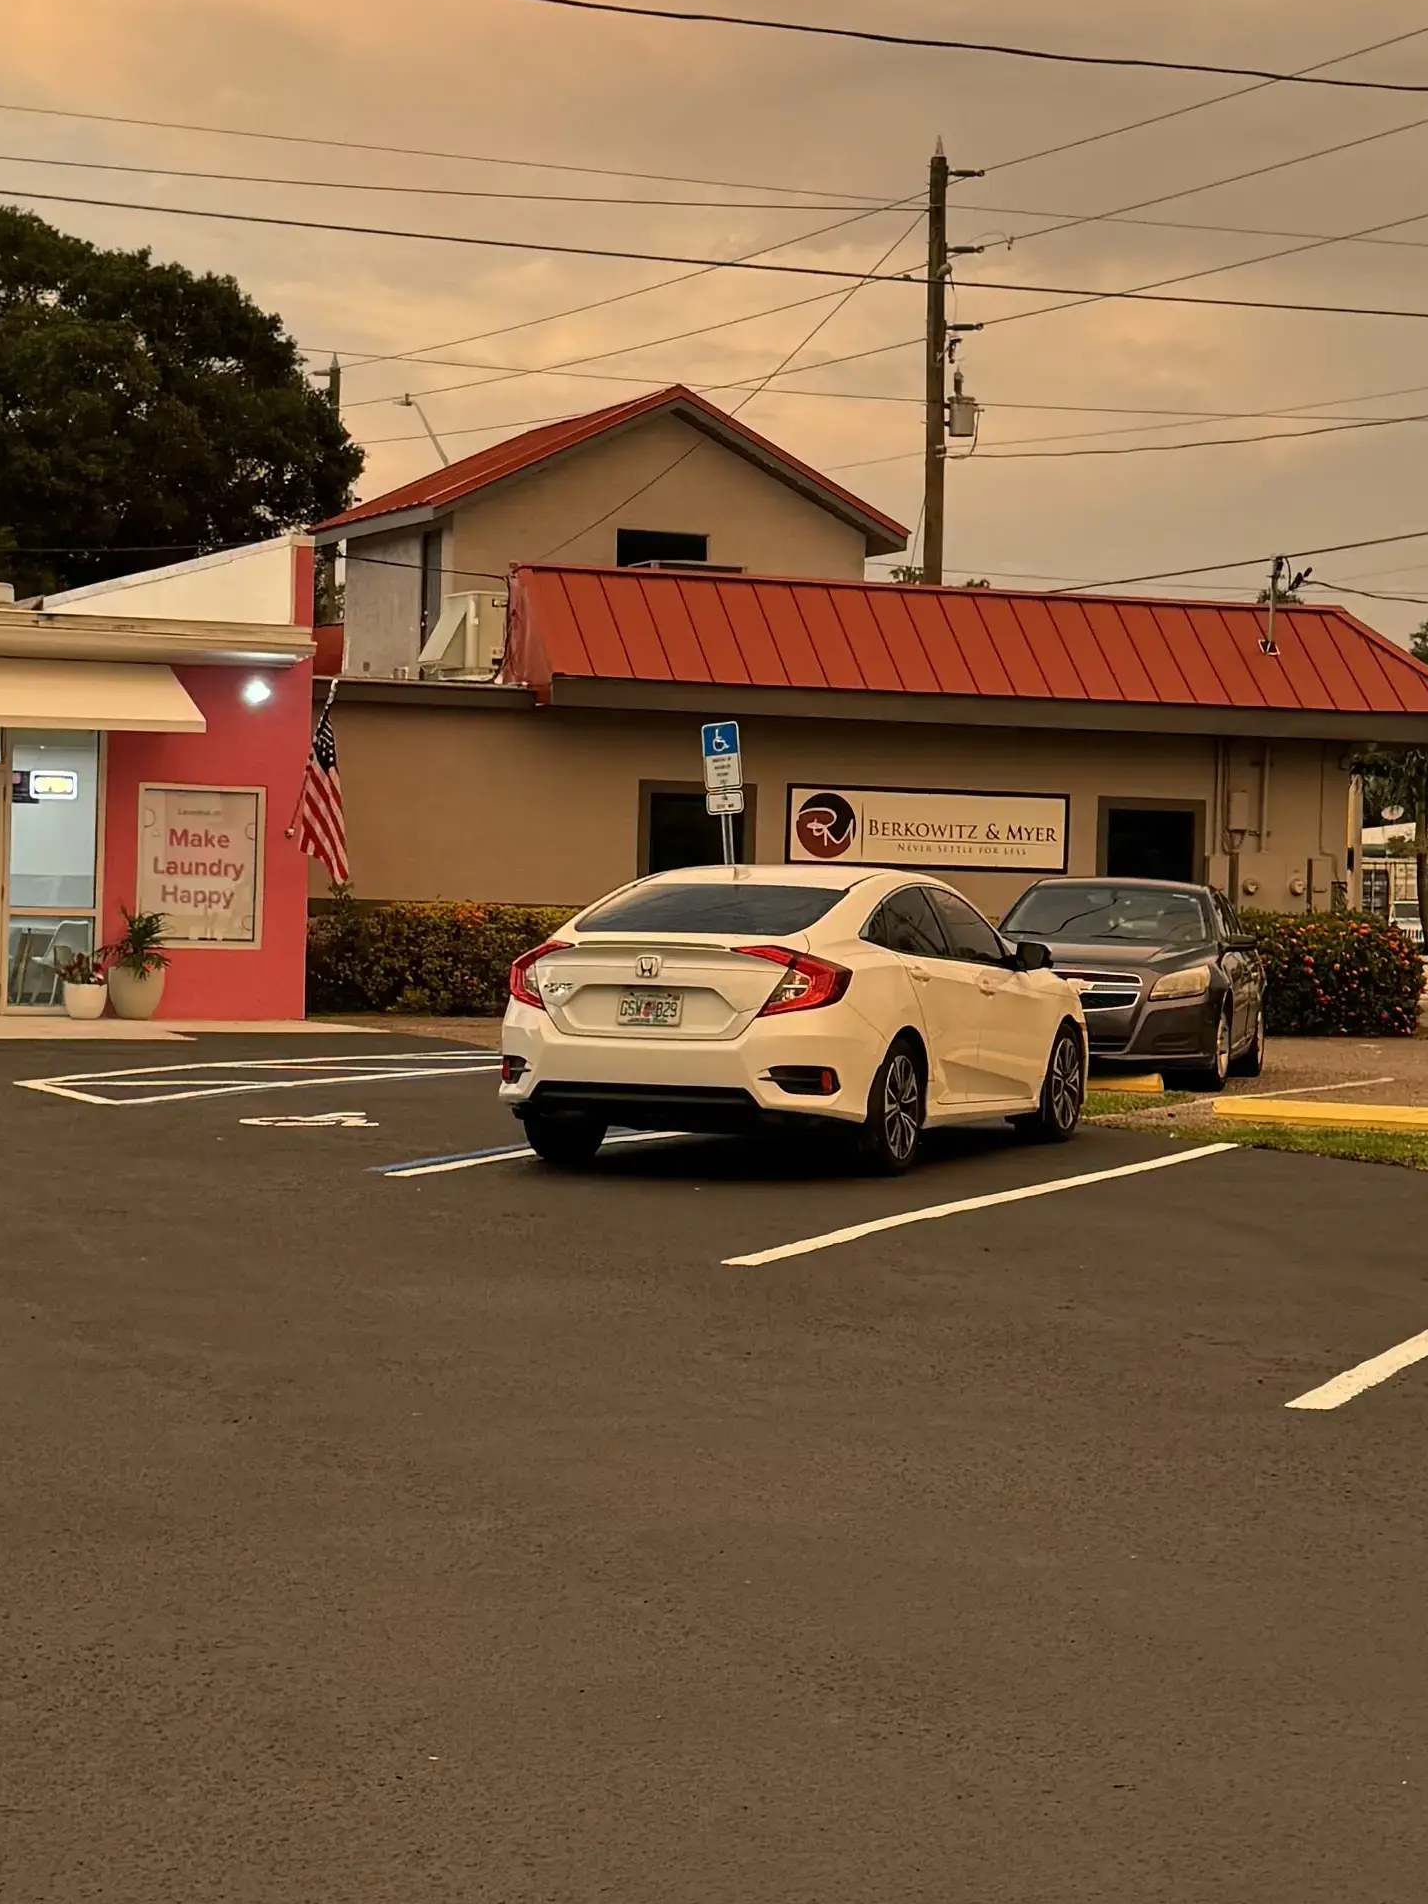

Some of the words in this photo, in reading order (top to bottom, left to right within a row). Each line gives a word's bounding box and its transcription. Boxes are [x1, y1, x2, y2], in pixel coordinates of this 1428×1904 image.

[169, 828, 230, 849] Make
[868, 818, 978, 840] BERKOWITZ
[985, 823, 1000, 840] &
[1006, 825, 1057, 842] MYER
[153, 856, 244, 881] Laundry
[161, 884, 234, 909] Happy
